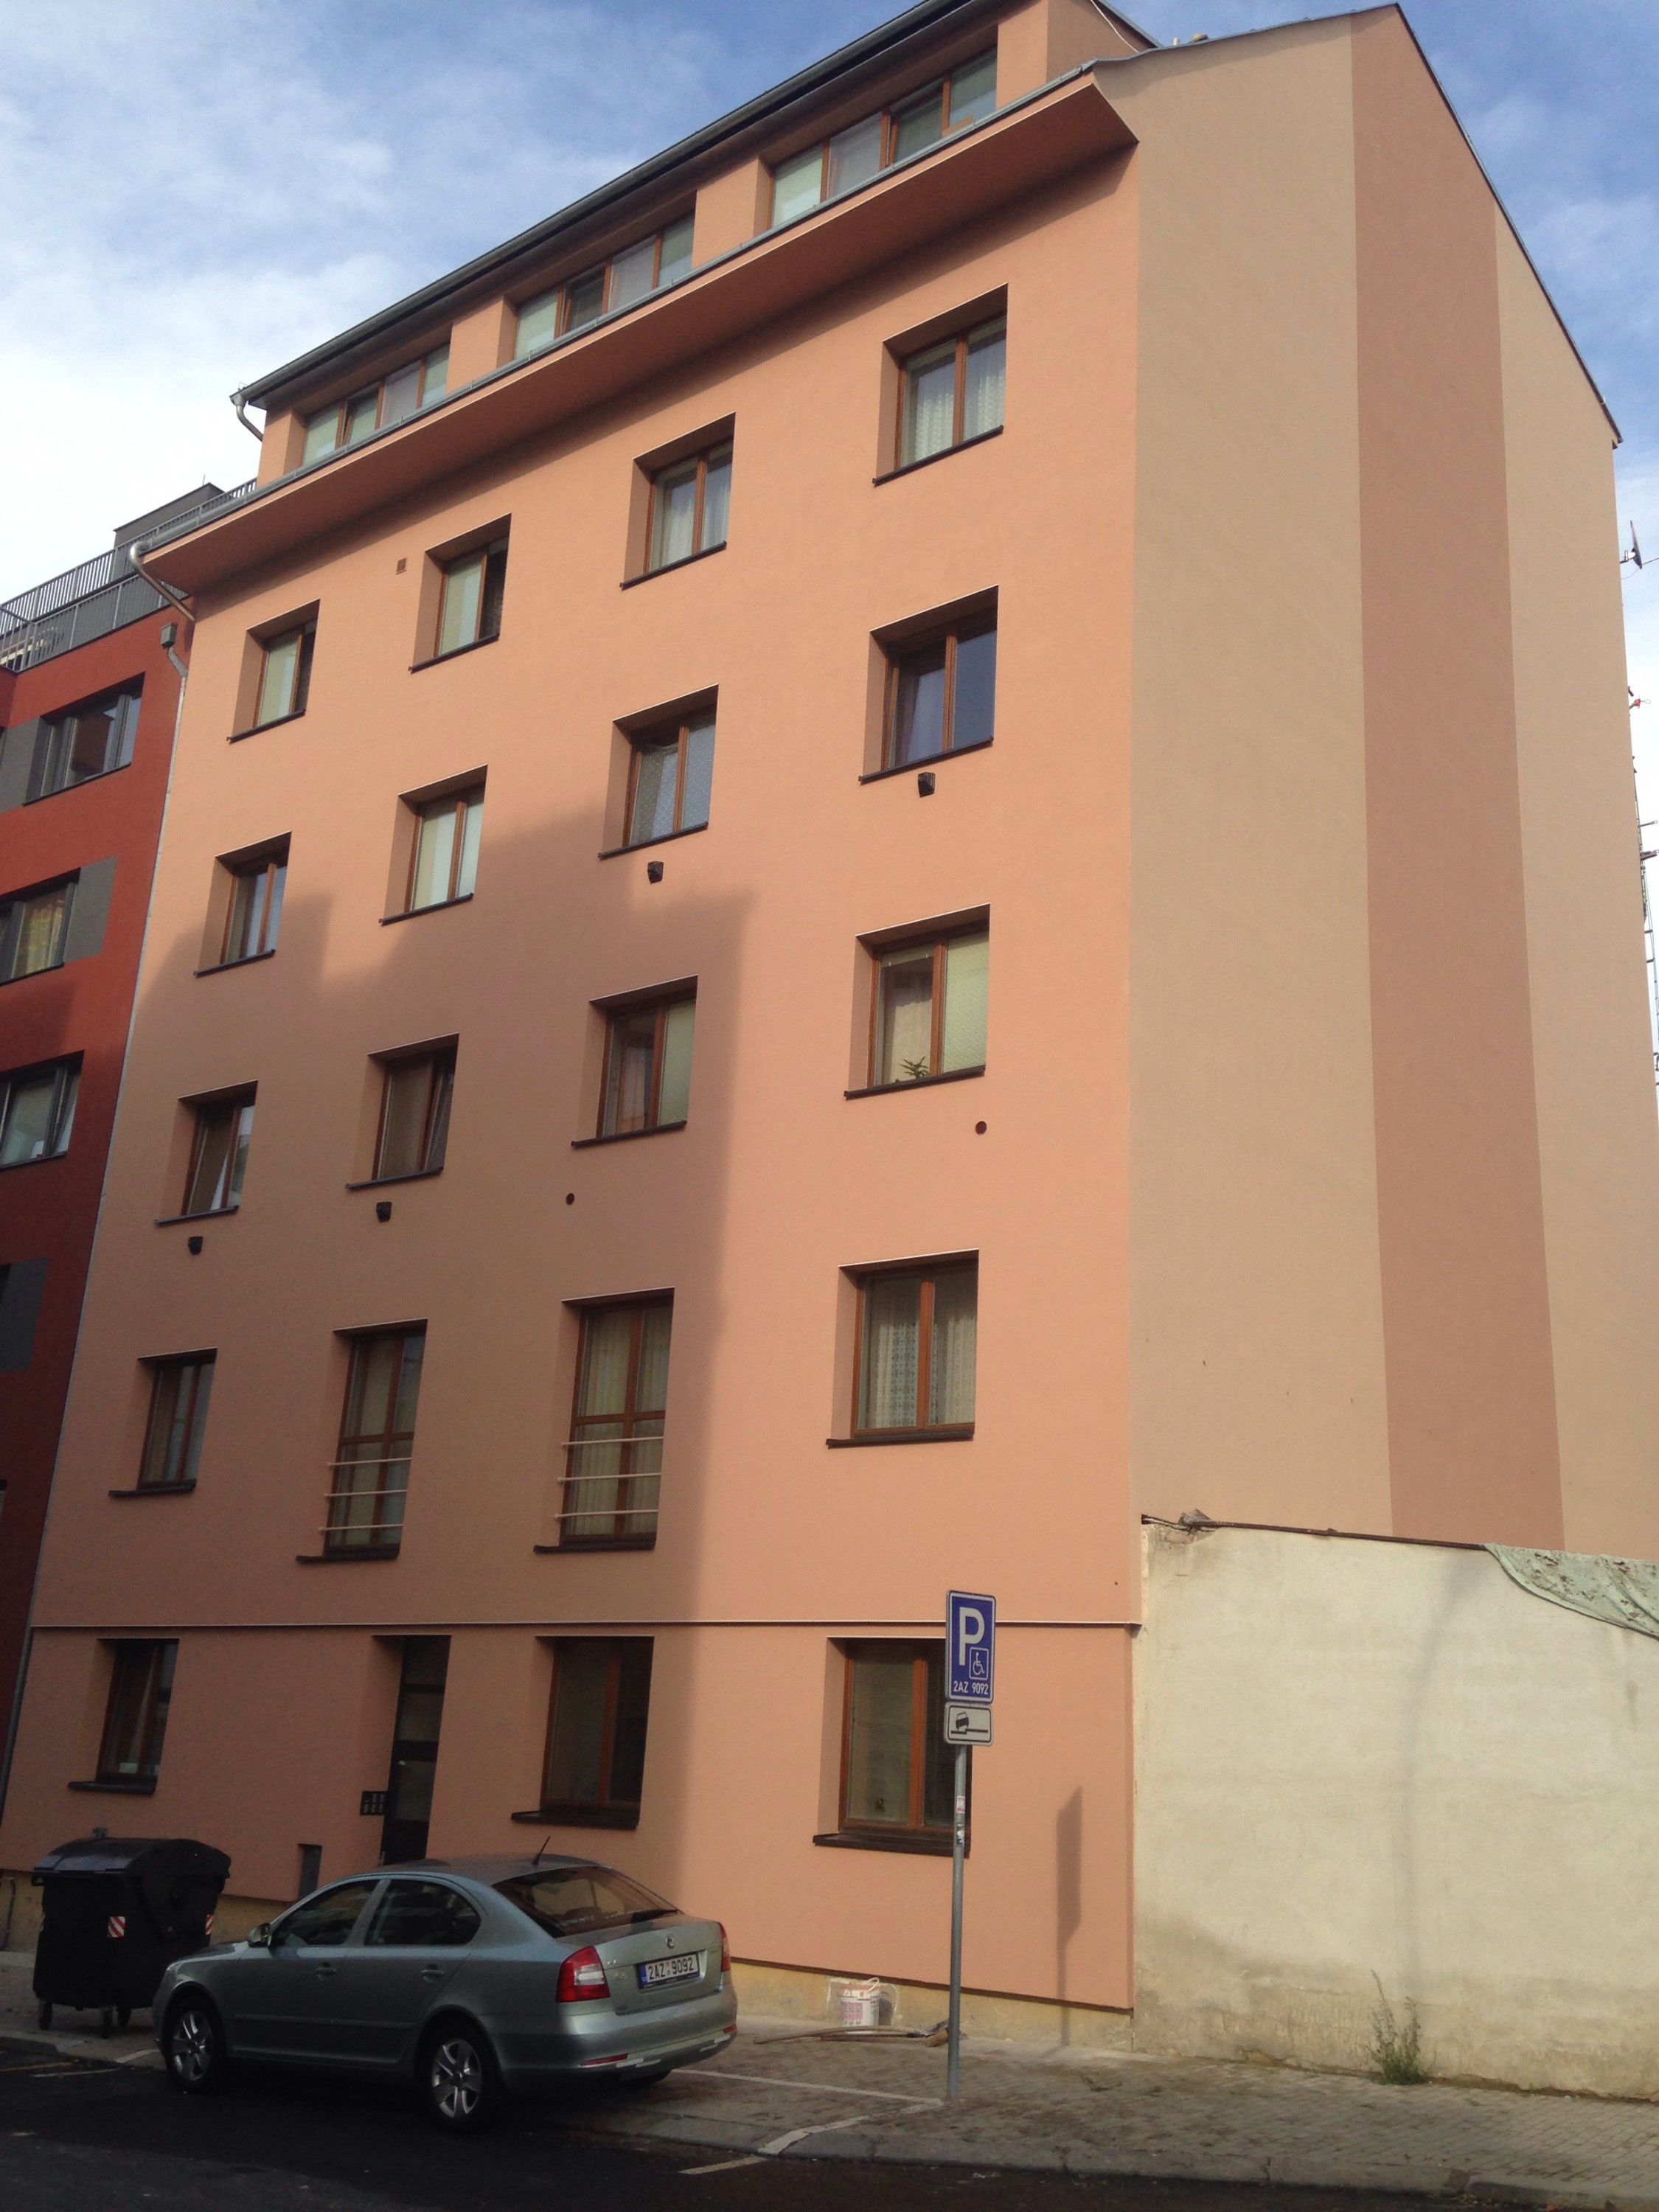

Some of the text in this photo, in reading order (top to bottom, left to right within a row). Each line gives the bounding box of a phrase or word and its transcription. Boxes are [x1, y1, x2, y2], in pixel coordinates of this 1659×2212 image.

[959, 1607, 985, 1666] P
[953, 1680, 989, 1694] 2AZ 9092
[648, 1957, 694, 1980] 2AZ 9092
